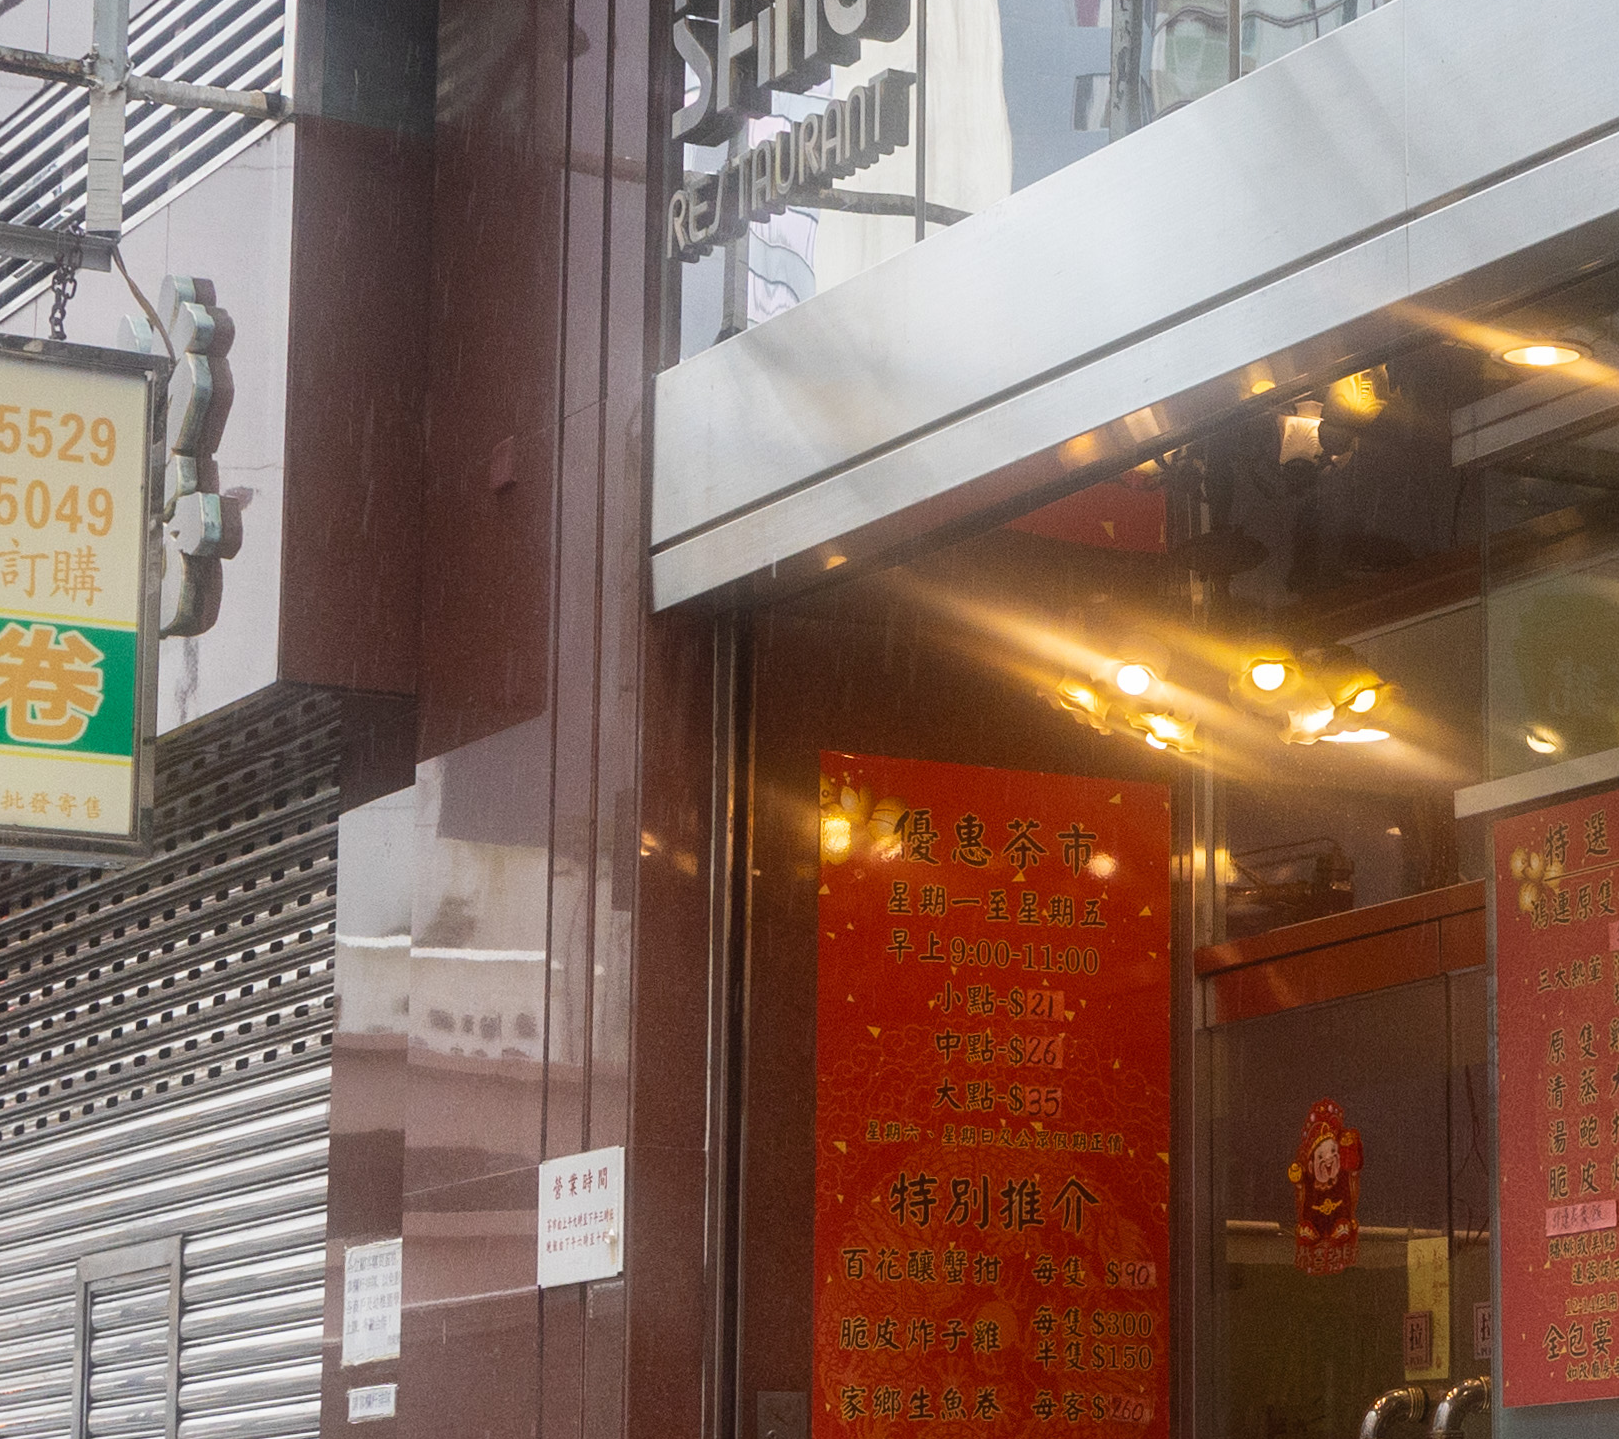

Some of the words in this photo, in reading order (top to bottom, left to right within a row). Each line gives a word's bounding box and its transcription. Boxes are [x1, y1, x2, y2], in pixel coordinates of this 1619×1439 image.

[666, 75, 891, 257] RESTAURANT
[893, 809, 1097, 877] 優惠茶市
[887, 880, 1107, 928] 星期一至星期五
[551, 1166, 609, 1201] 營業時間
[889, 1171, 1100, 1234] 特別推介
[839, 1316, 1001, 1353] 脆皮炸子雞
[1543, 1318, 1612, 1360] 全包宴
[840, 1384, 1001, 1421] 家鄉生魚卷
